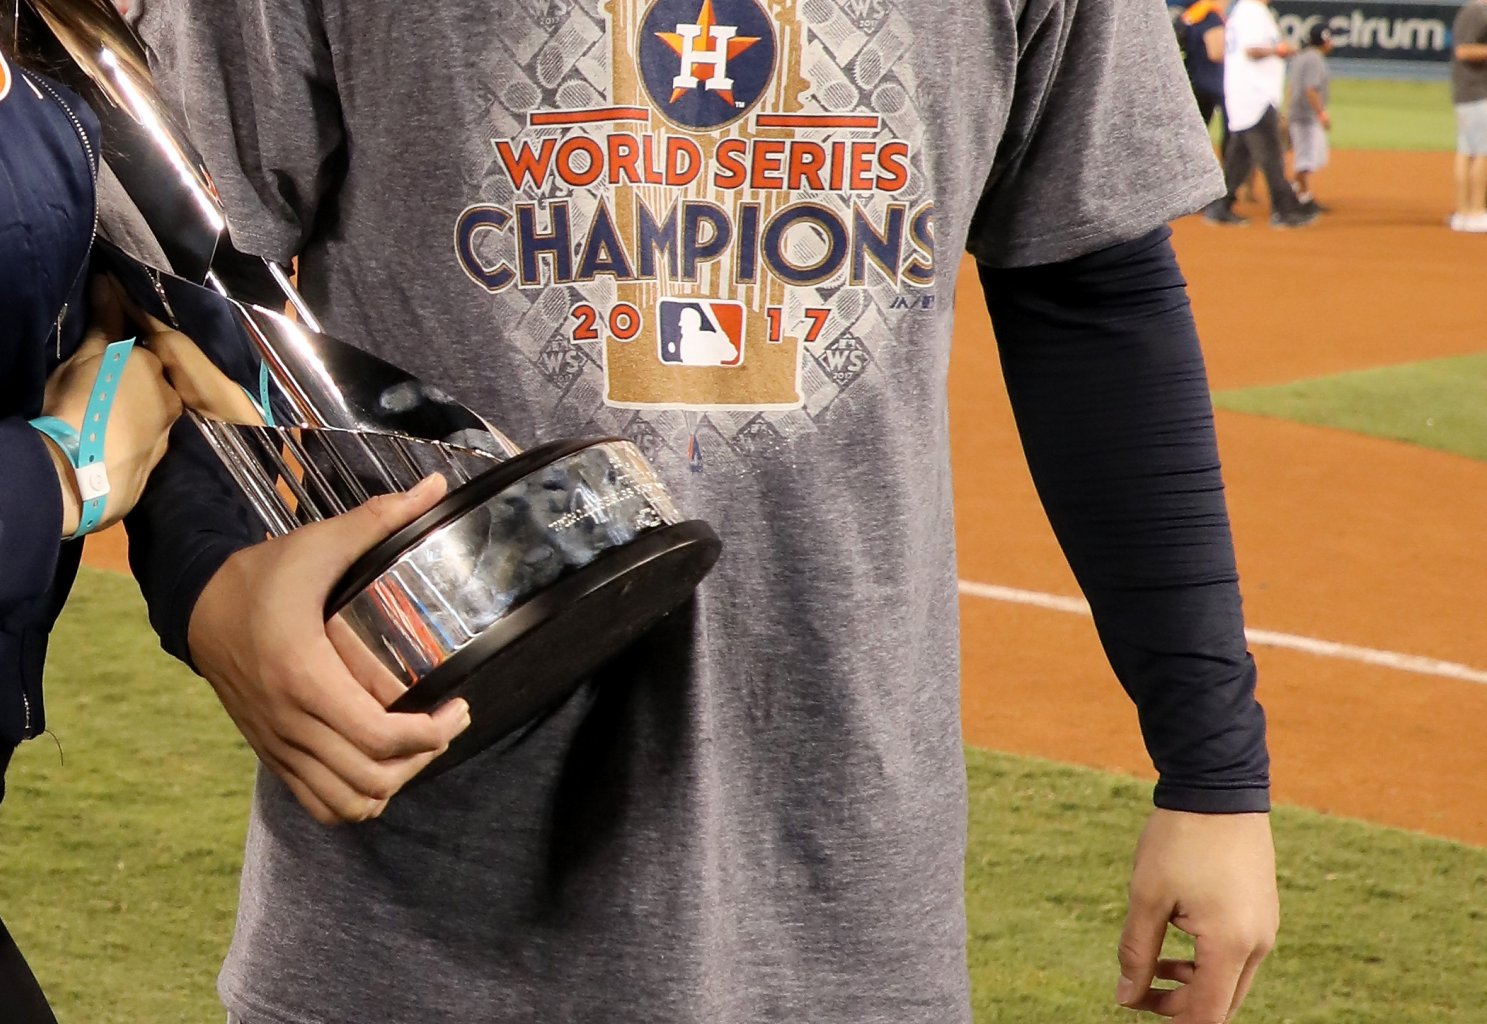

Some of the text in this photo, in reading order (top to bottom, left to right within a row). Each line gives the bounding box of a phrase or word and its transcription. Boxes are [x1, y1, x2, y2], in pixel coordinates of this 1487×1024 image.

[672, 23, 738, 91] H
[496, 130, 911, 192] WORLD SERIES
[455, 193, 935, 293] CHAMPIONS
[570, 303, 831, 344] 20 17
[825, 349, 864, 373] WS
